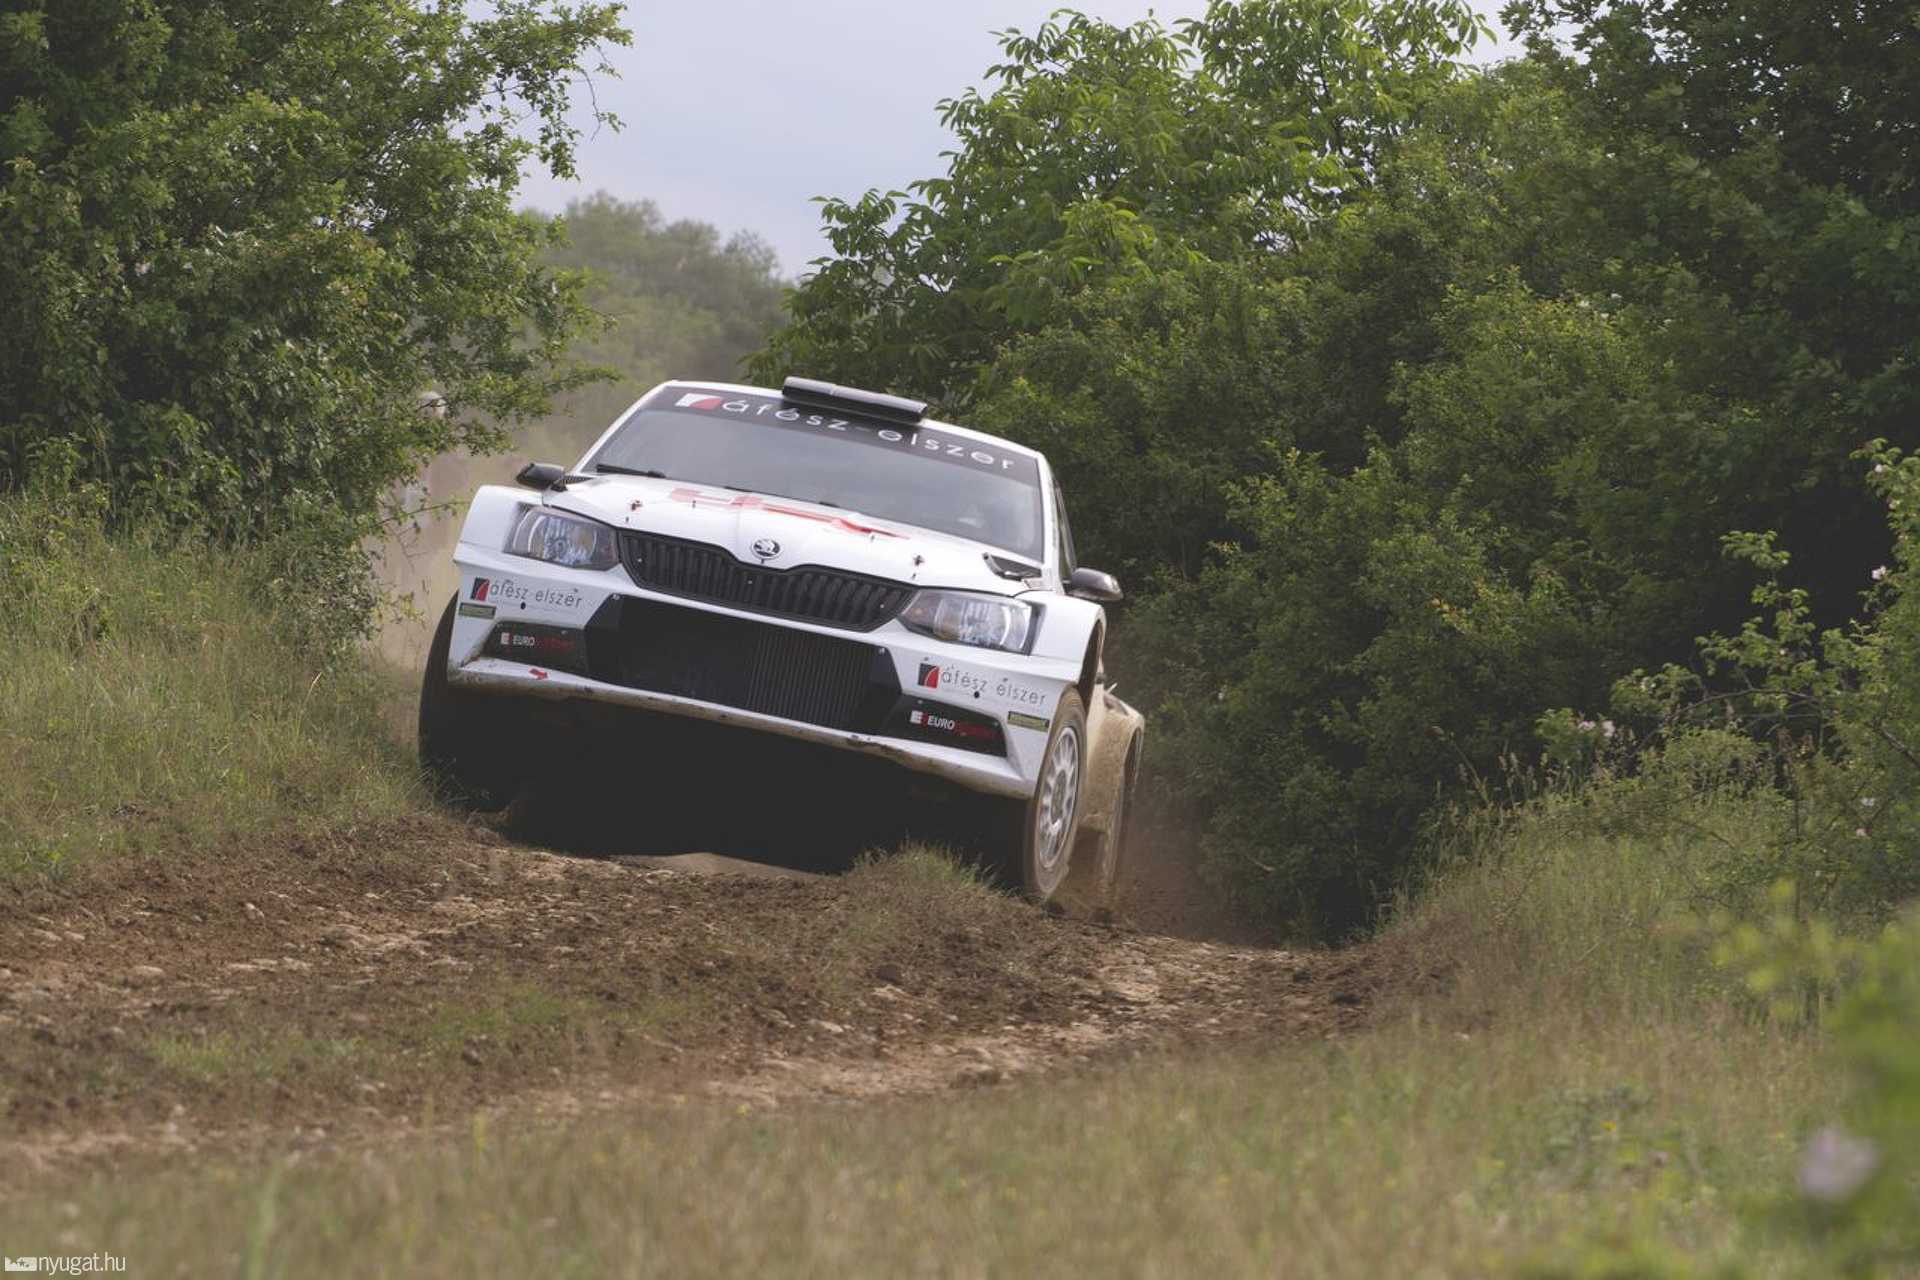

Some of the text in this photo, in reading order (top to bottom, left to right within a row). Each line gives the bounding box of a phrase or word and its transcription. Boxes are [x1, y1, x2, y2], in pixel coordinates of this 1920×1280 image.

[877, 429, 1016, 470] elszer
[535, 588, 582, 608] elszer
[512, 634, 535, 646] EURO
[996, 683, 1046, 705] elszer
[927, 714, 956, 730] EURO
